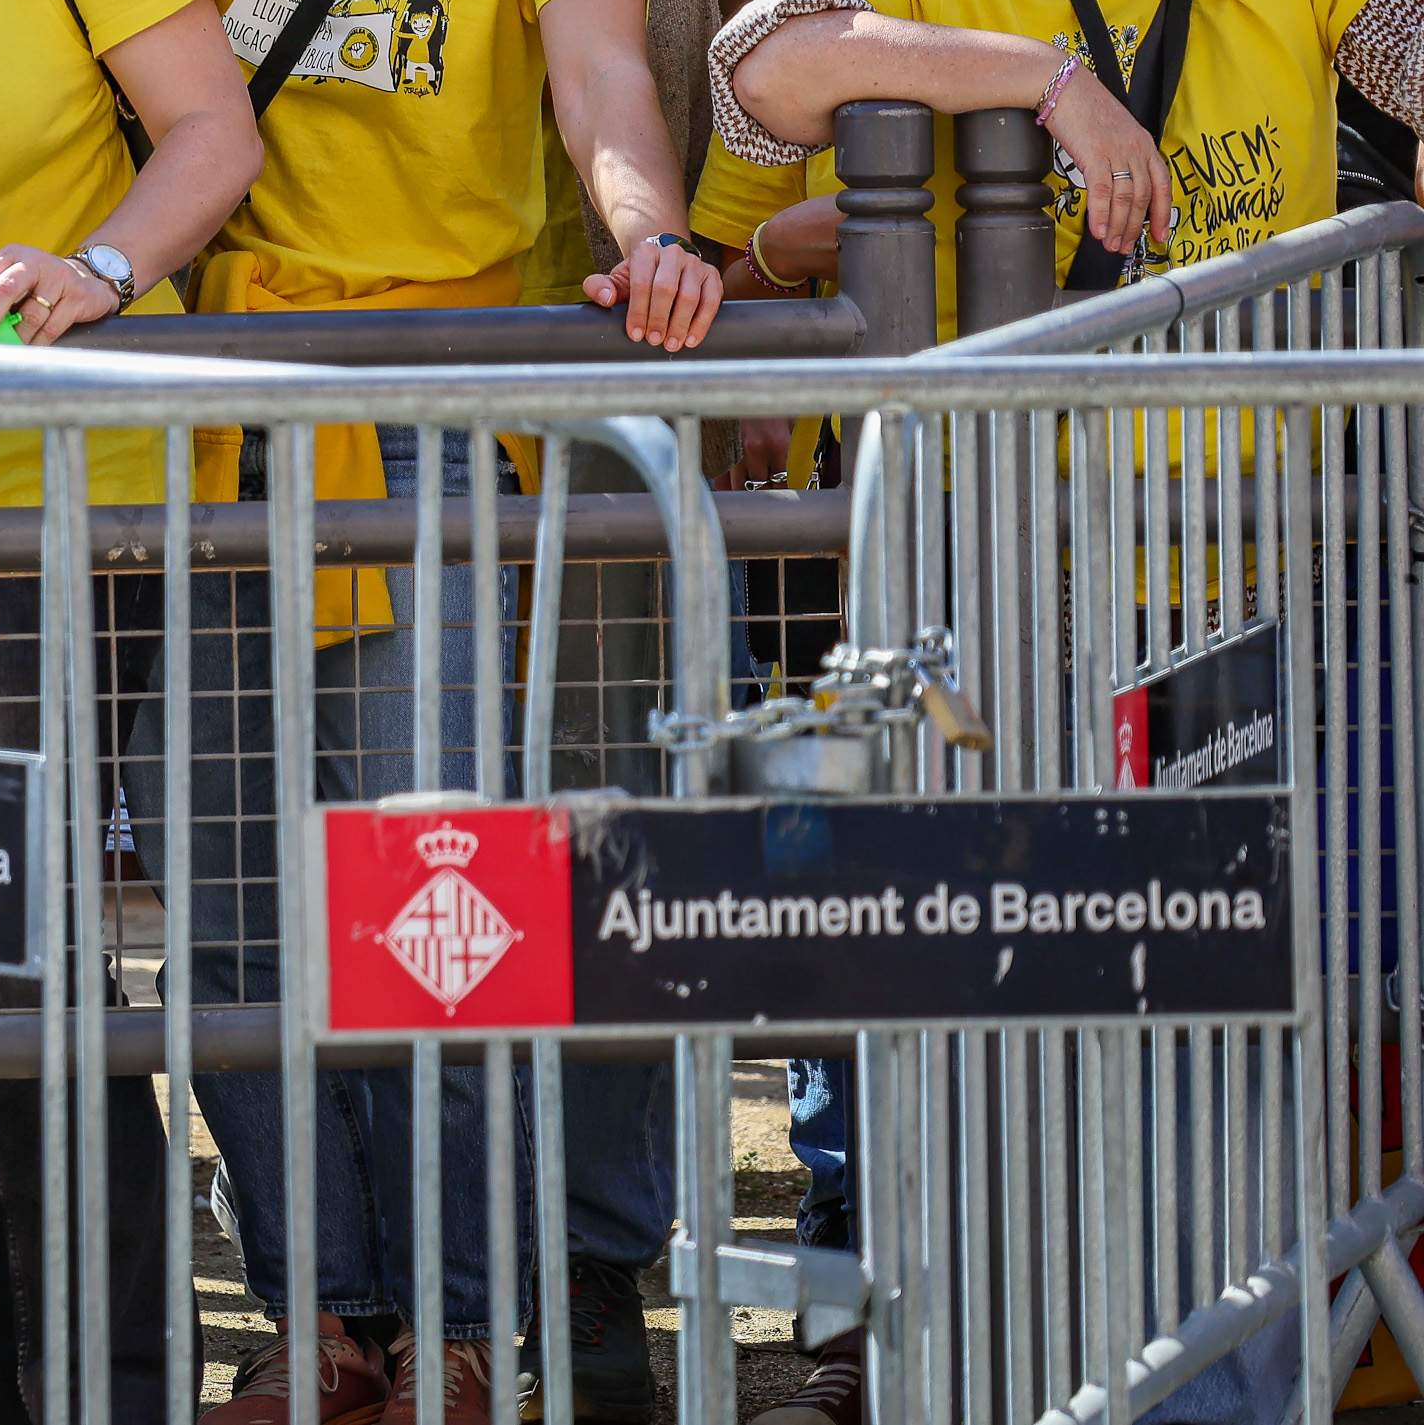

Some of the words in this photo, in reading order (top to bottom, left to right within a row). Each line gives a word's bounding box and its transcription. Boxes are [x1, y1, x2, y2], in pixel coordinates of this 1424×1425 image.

[297, 43, 335, 73] ÚBLICA
[1170, 124, 1275, 196] ENSEM
[1214, 727, 1227, 776] de
[1227, 708, 1274, 769] Barcelona
[598, 885, 905, 953] Ajuntament
[915, 882, 981, 934] de
[990, 878, 1267, 934] Barcelona
